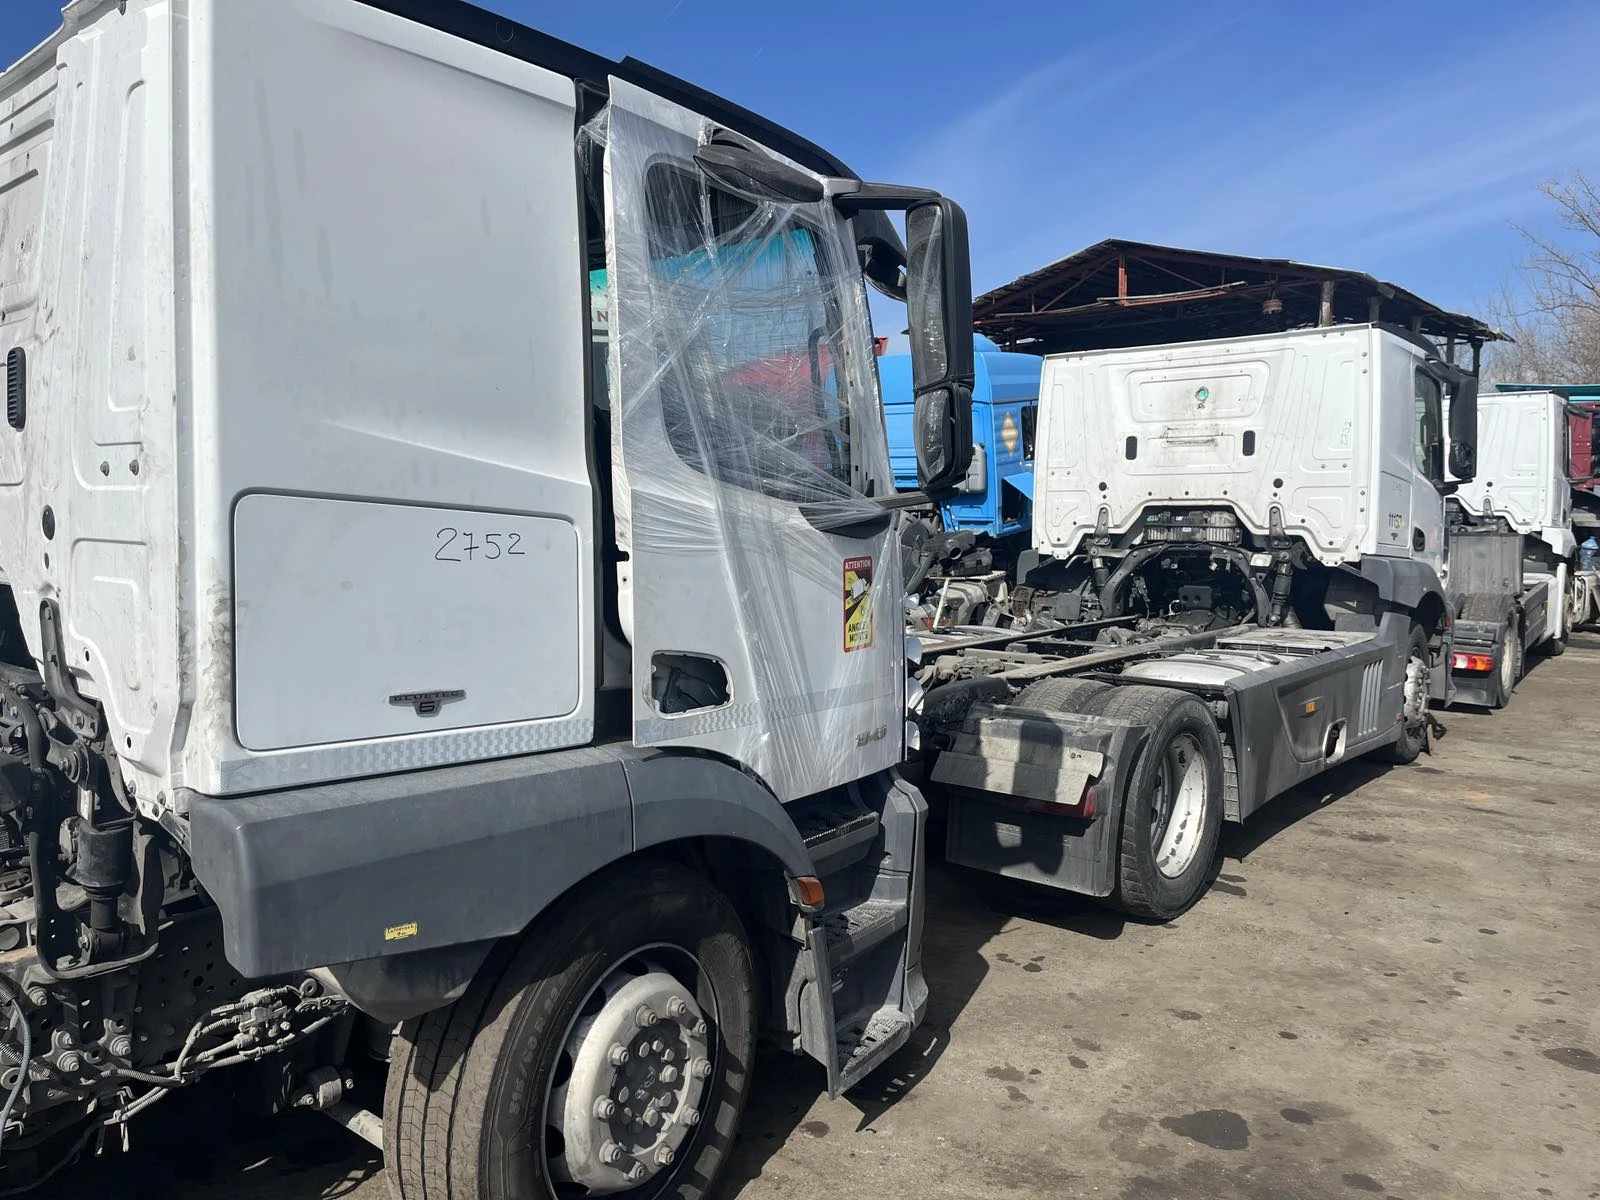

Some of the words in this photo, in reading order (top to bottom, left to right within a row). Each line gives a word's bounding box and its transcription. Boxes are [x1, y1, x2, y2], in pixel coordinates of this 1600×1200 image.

[435, 527, 526, 562] 2752
[845, 559, 871, 569] ATTENTION
[848, 622, 868, 634] ANGLE
[420, 701, 435, 713] 6
